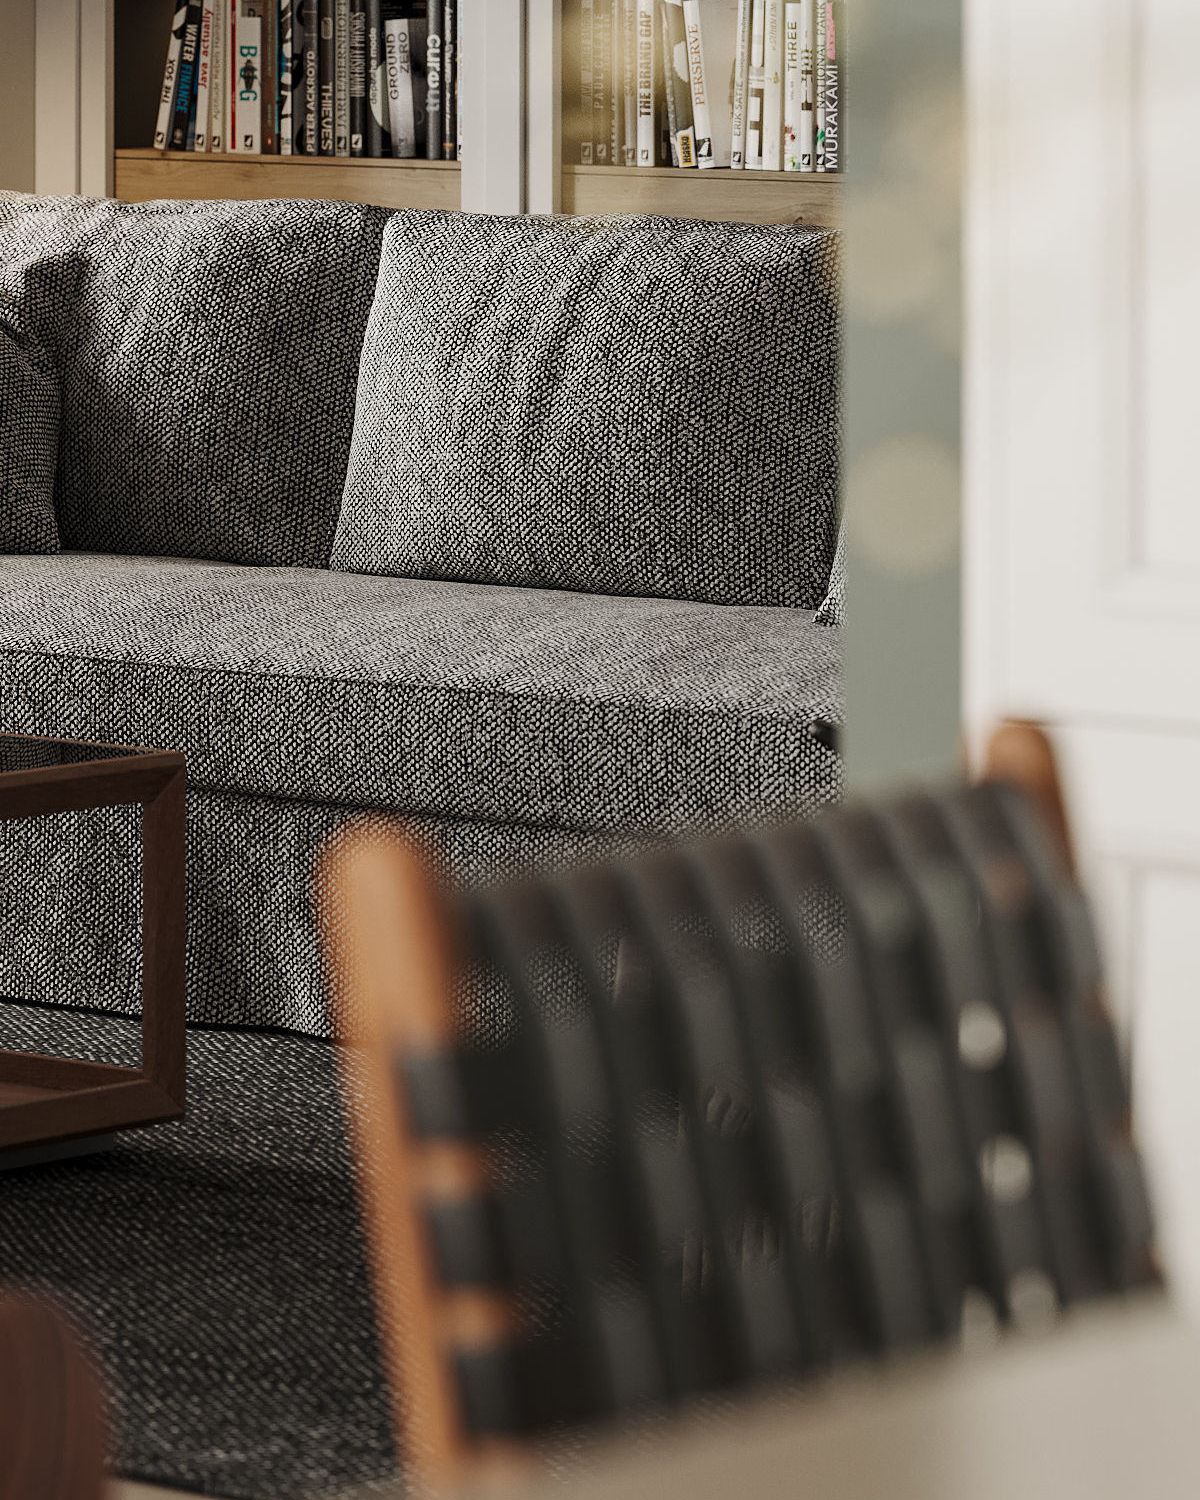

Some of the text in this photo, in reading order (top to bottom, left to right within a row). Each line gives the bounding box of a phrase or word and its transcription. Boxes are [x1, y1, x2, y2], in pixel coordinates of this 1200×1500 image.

[176, 24, 199, 114] WATER FINANCE
[198, 8, 214, 89] Java actually
[239, 45, 258, 101] BUG
[349, 11, 366, 98] UNIVERSITY PHYSICS
[369, 27, 377, 58] mode
[385, 31, 410, 100] GROUND ZERO
[639, 9, 651, 117] THE BRAND GAP
[687, 23, 705, 105] PERSERVE
[787, 21, 797, 72] THREE
[815, 2, 825, 109] NATIONAL PARK
[163, 58, 176, 104] THE SOX
[306, 51, 316, 152] PETER ACKROYD
[321, 82, 333, 151] THIEVES
[735, 81, 744, 111] SATIE
[825, 64, 839, 169] MURAKAMI
[733, 112, 741, 137] ERIK
